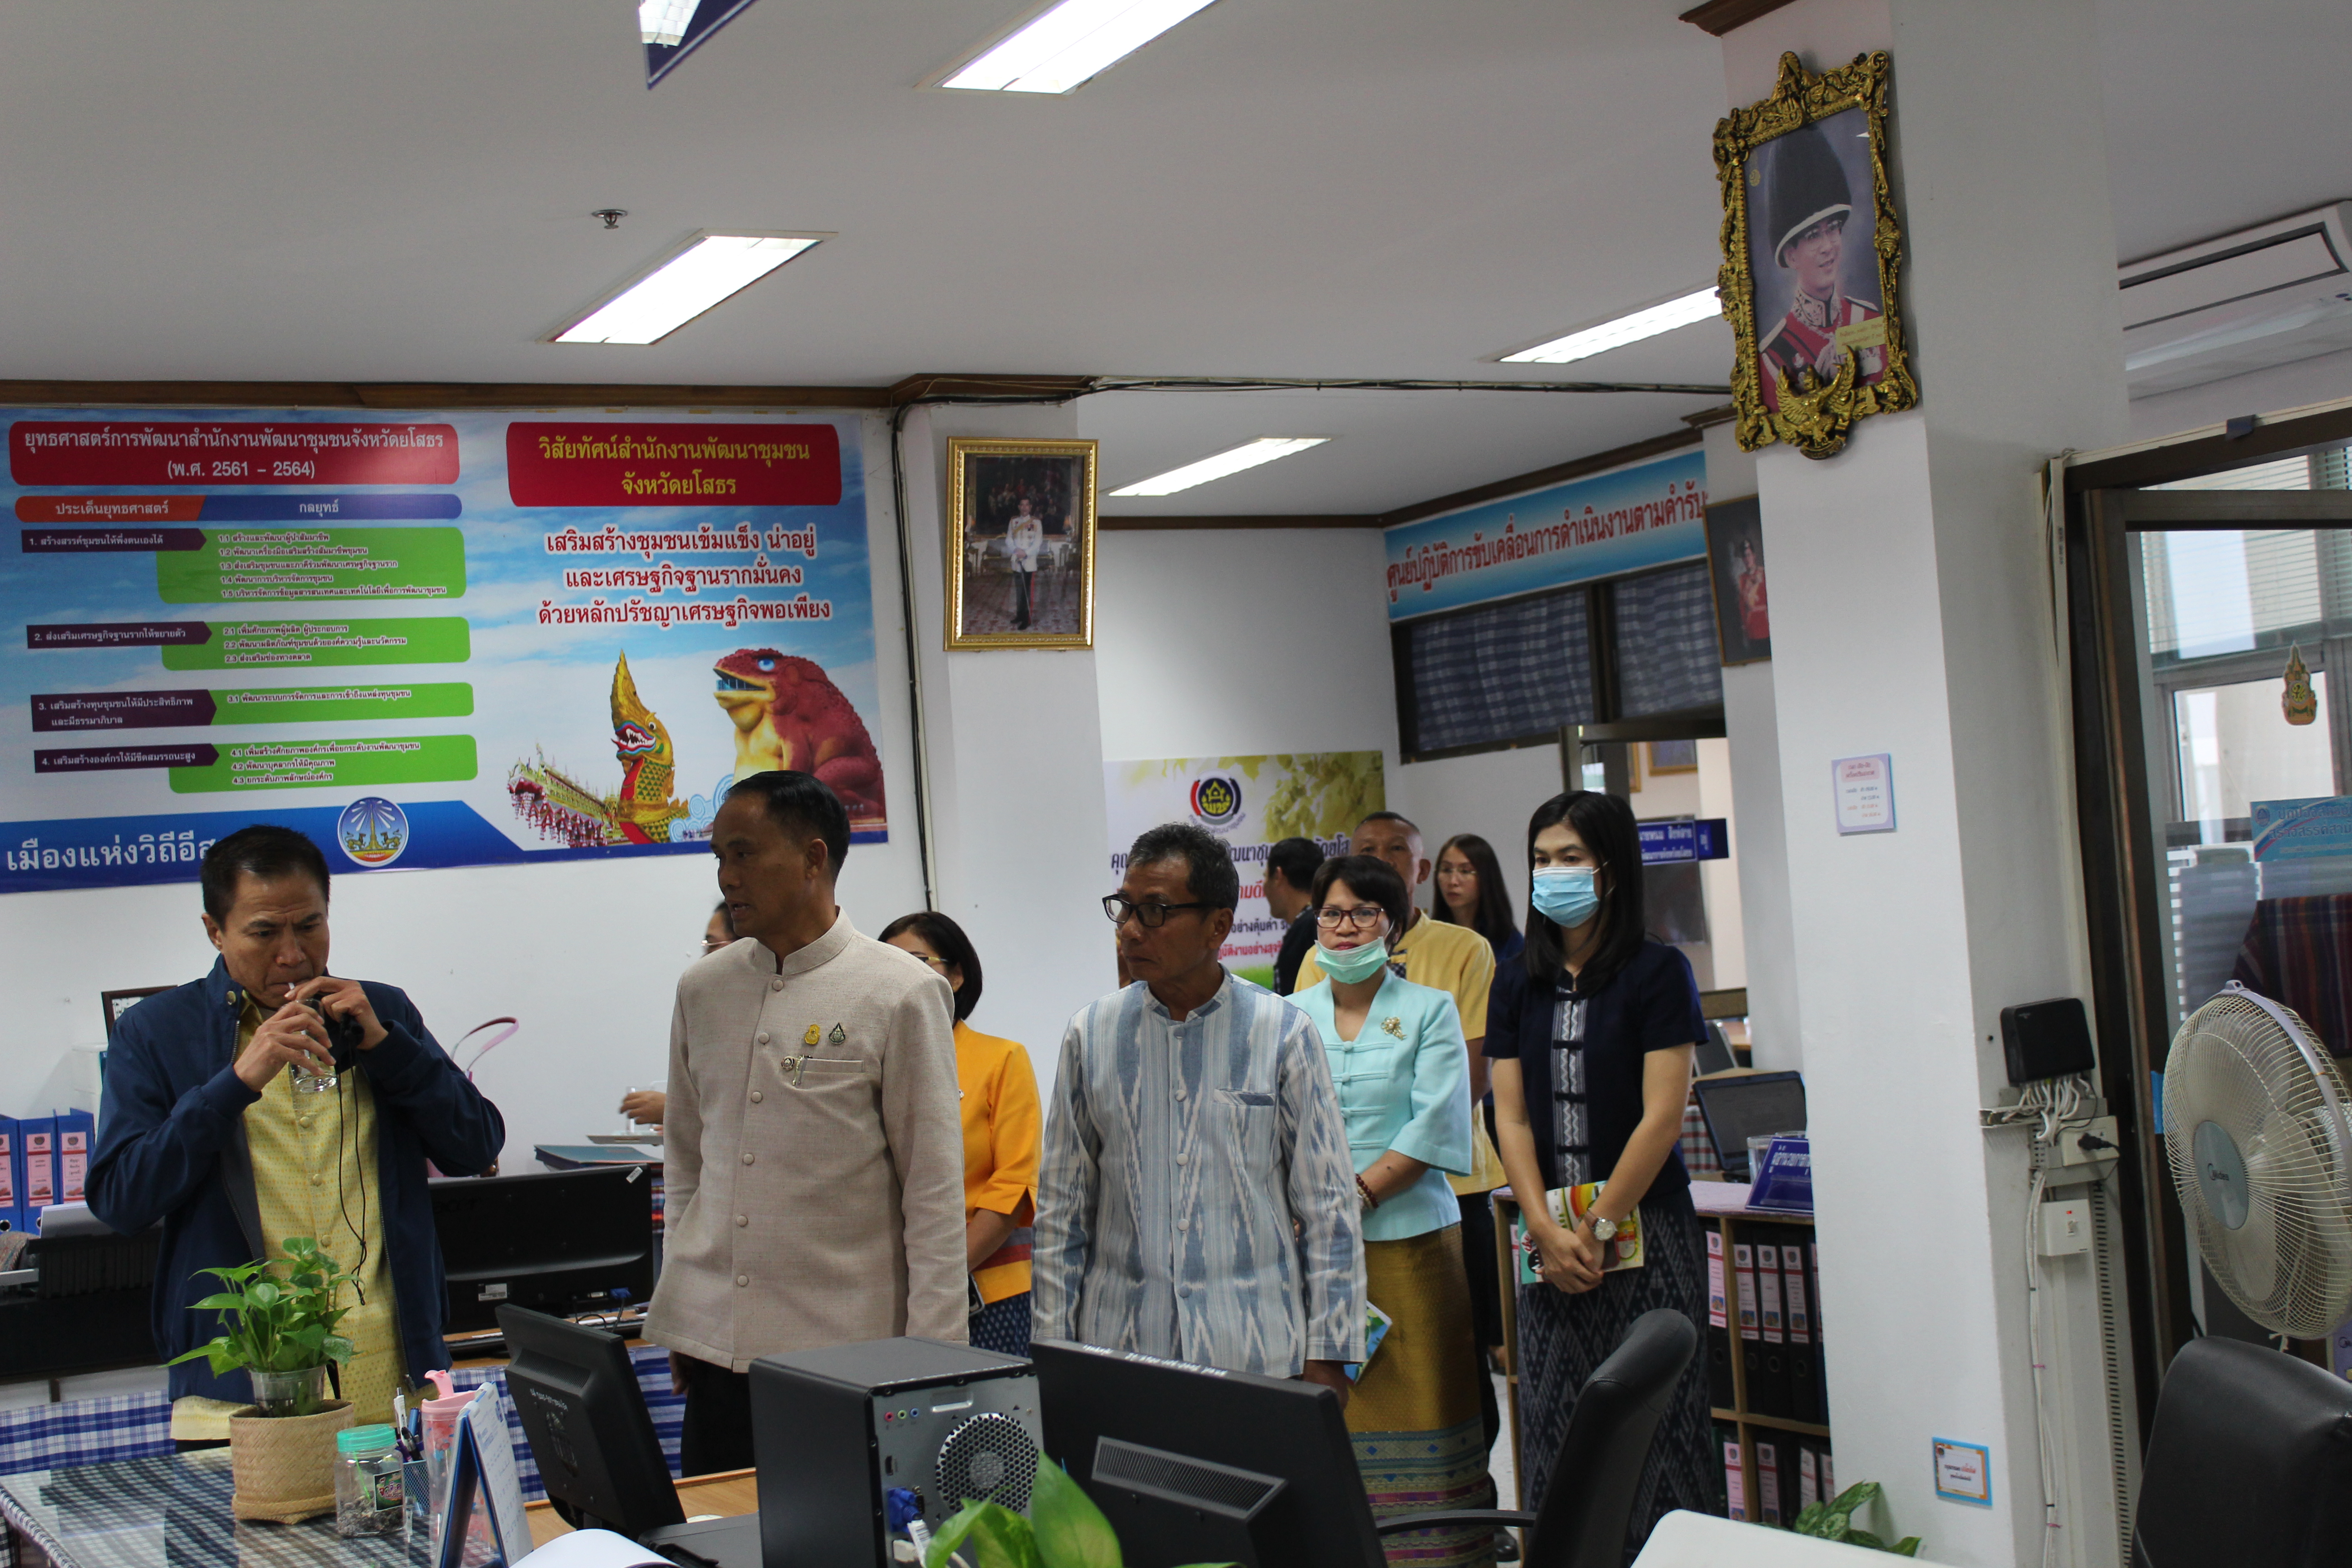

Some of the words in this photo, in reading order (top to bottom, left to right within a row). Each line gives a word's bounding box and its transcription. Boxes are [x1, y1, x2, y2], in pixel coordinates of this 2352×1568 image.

[25, 426, 444, 453] ยุทธศาสตร์การพัฒนาสำนักงานพัฒนาชุมชนจังหวัดยโสธร
[539, 435, 810, 466] วิสัยทัศน์สำนักงานพัฒนาชุมชน
[167, 461, 205, 479] (พ.ศ.
[212, 461, 248, 476] 2561
[273, 461, 315, 479] 2564)
[622, 469, 736, 495] จังหวัดยโสธร
[55, 500, 169, 518] ประเด็นยุทธศาสตร์
[299, 499, 339, 517] กลยุทธ์
[219, 534, 230, 542] 1.1
[547, 524, 759, 559] เสริมสร้างชุมชนเข้มแข็ง
[767, 525, 815, 556] น่าอยู่
[1387, 480, 1708, 602] ศูนย์ปฏิบัติการขับเคลื่อนการดำเนินงานตามคำรับ
[220, 548, 231, 556] 1.2
[220, 562, 232, 570] 1.3
[566, 556, 801, 592] และเศรษฐกิจฐานรากมั่นคง
[221, 576, 233, 584] 1.4
[539, 595, 830, 627] ด้วยหลักปรัชญาเศรษฐกิจพอเพียง
